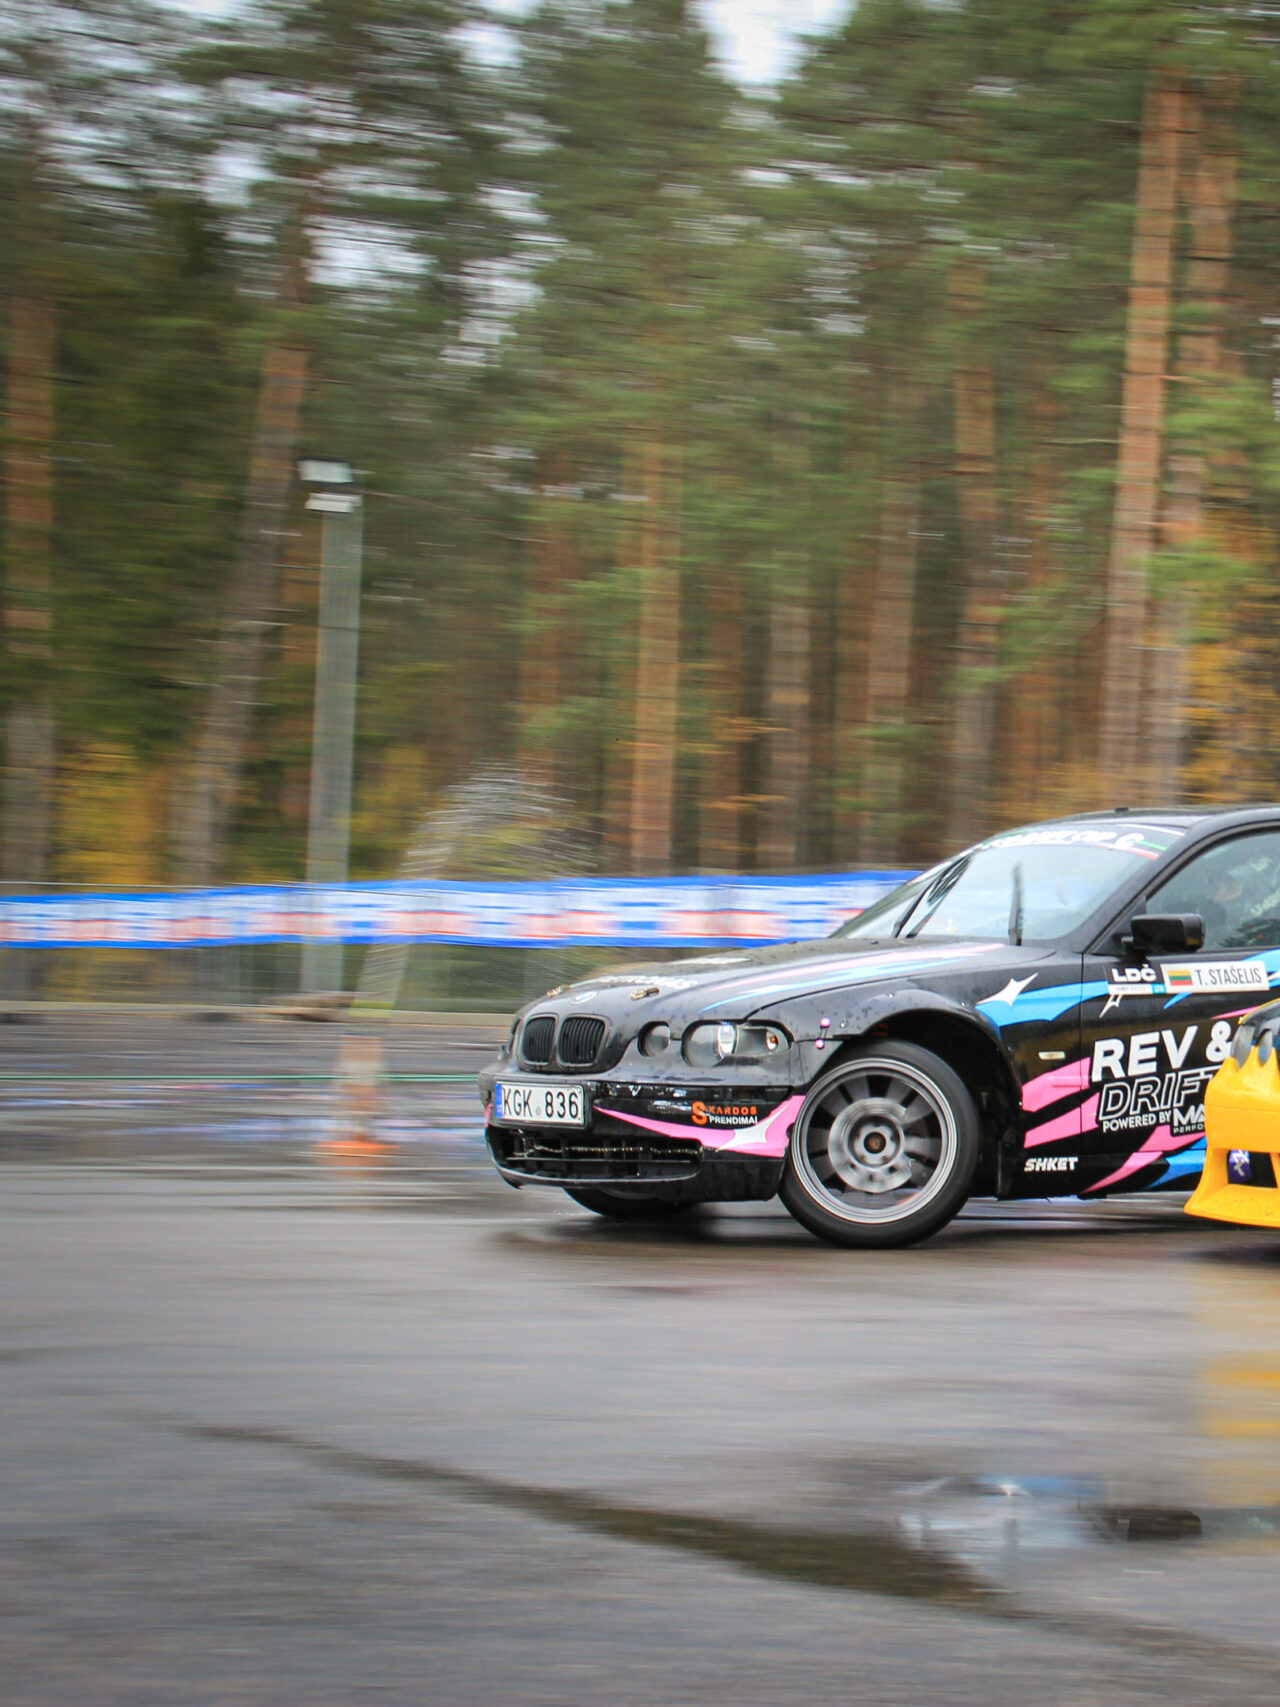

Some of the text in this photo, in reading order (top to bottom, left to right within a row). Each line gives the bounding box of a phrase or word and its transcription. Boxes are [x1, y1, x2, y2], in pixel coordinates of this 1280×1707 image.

[1111, 963, 1157, 983] LDČ
[1195, 964, 1263, 986] T. STAŠELIS
[1091, 1020, 1232, 1083] REV &
[502, 1087, 533, 1117] KGK
[545, 1090, 579, 1119] 836
[709, 1115, 758, 1125] PRENDIMAI
[1102, 1109, 1173, 1133] POWERED BY
[1023, 1156, 1079, 1172] SHKET
